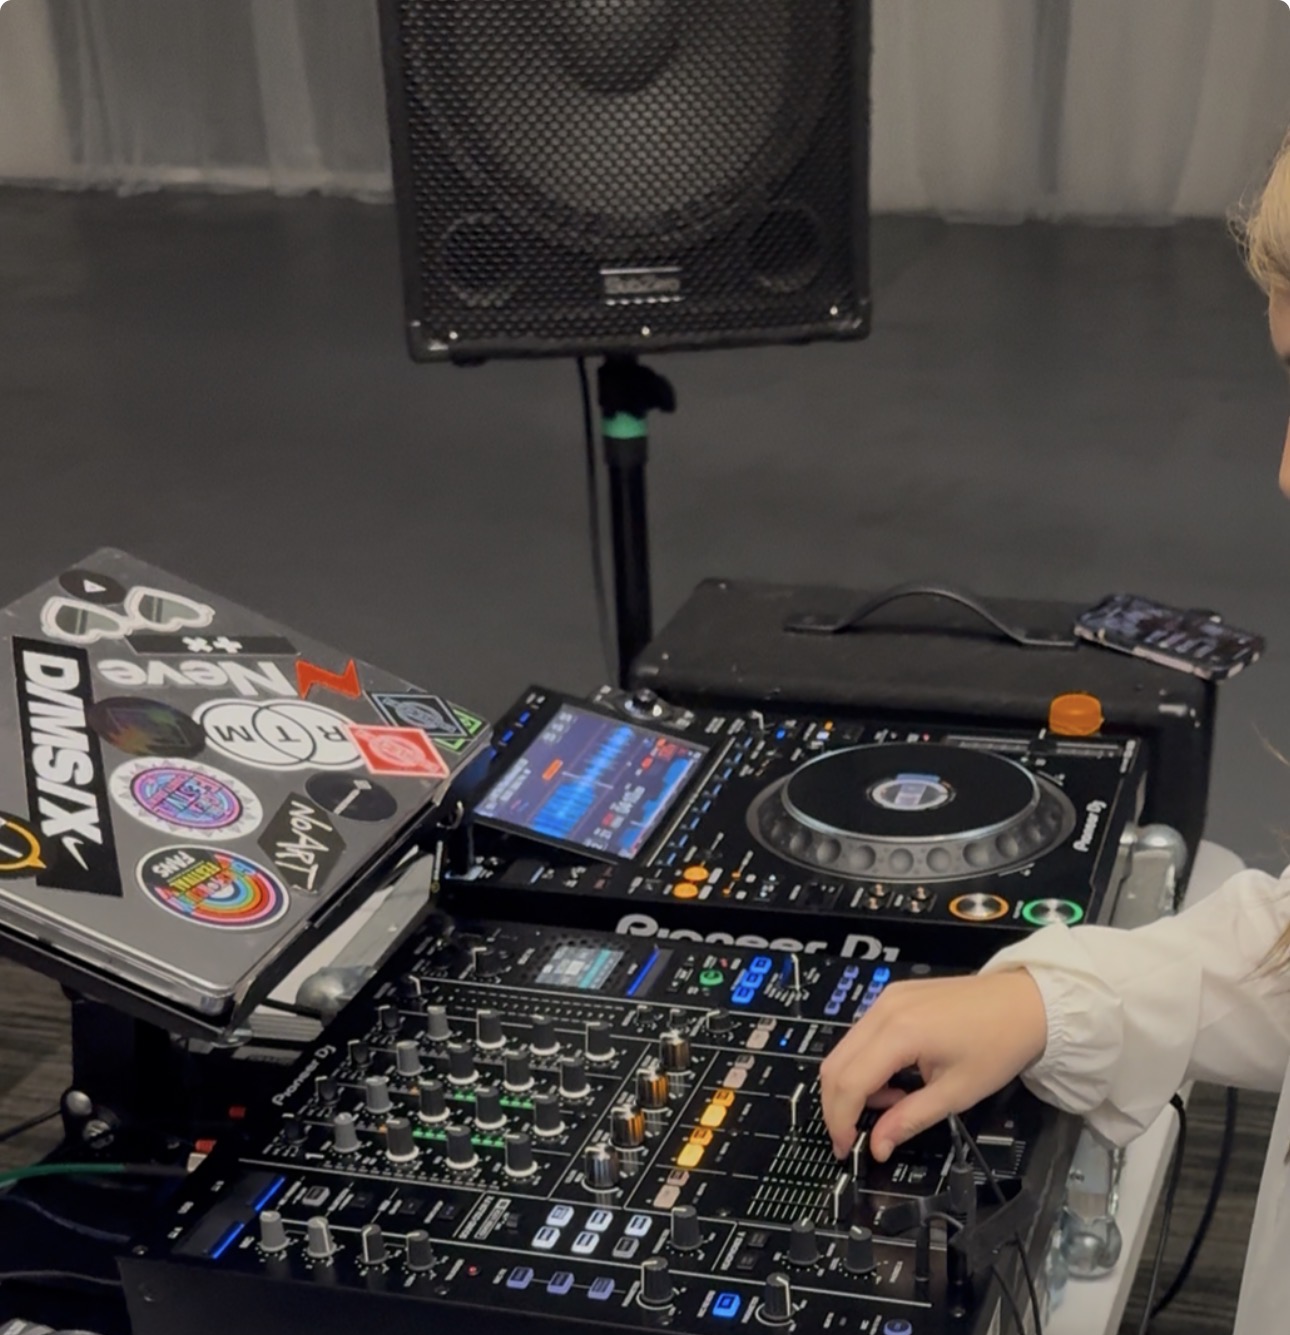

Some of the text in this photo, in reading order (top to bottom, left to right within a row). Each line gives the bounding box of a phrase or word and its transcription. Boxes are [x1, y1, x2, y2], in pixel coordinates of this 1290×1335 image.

[98, 659, 300, 697] Neve
[151, 850, 196, 879] FANS
[271, 1059, 320, 1106] Pioneer
